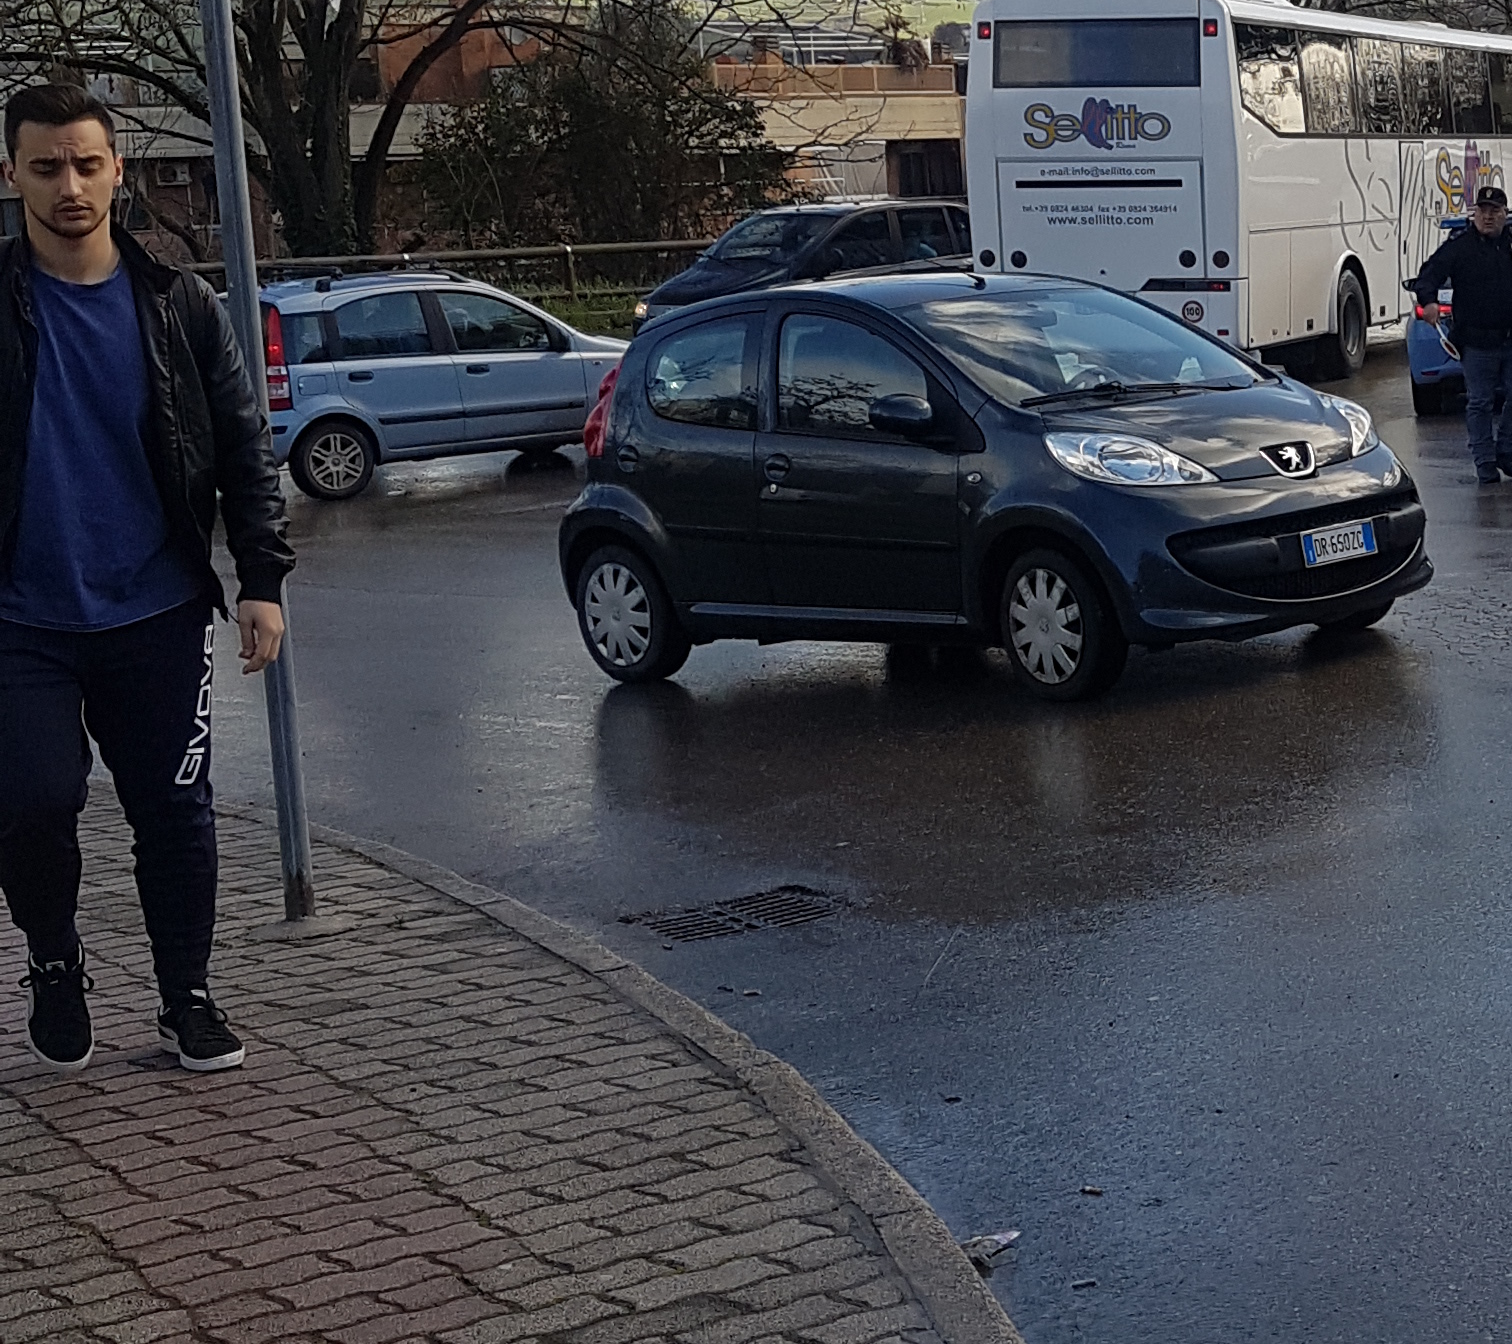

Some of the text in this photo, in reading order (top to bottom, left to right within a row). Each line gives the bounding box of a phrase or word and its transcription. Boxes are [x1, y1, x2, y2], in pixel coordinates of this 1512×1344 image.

[1047, 215, 1154, 226] www.sellitto.com
[1186, 307, 1200, 316] 100
[174, 624, 214, 785] GIVOVA
